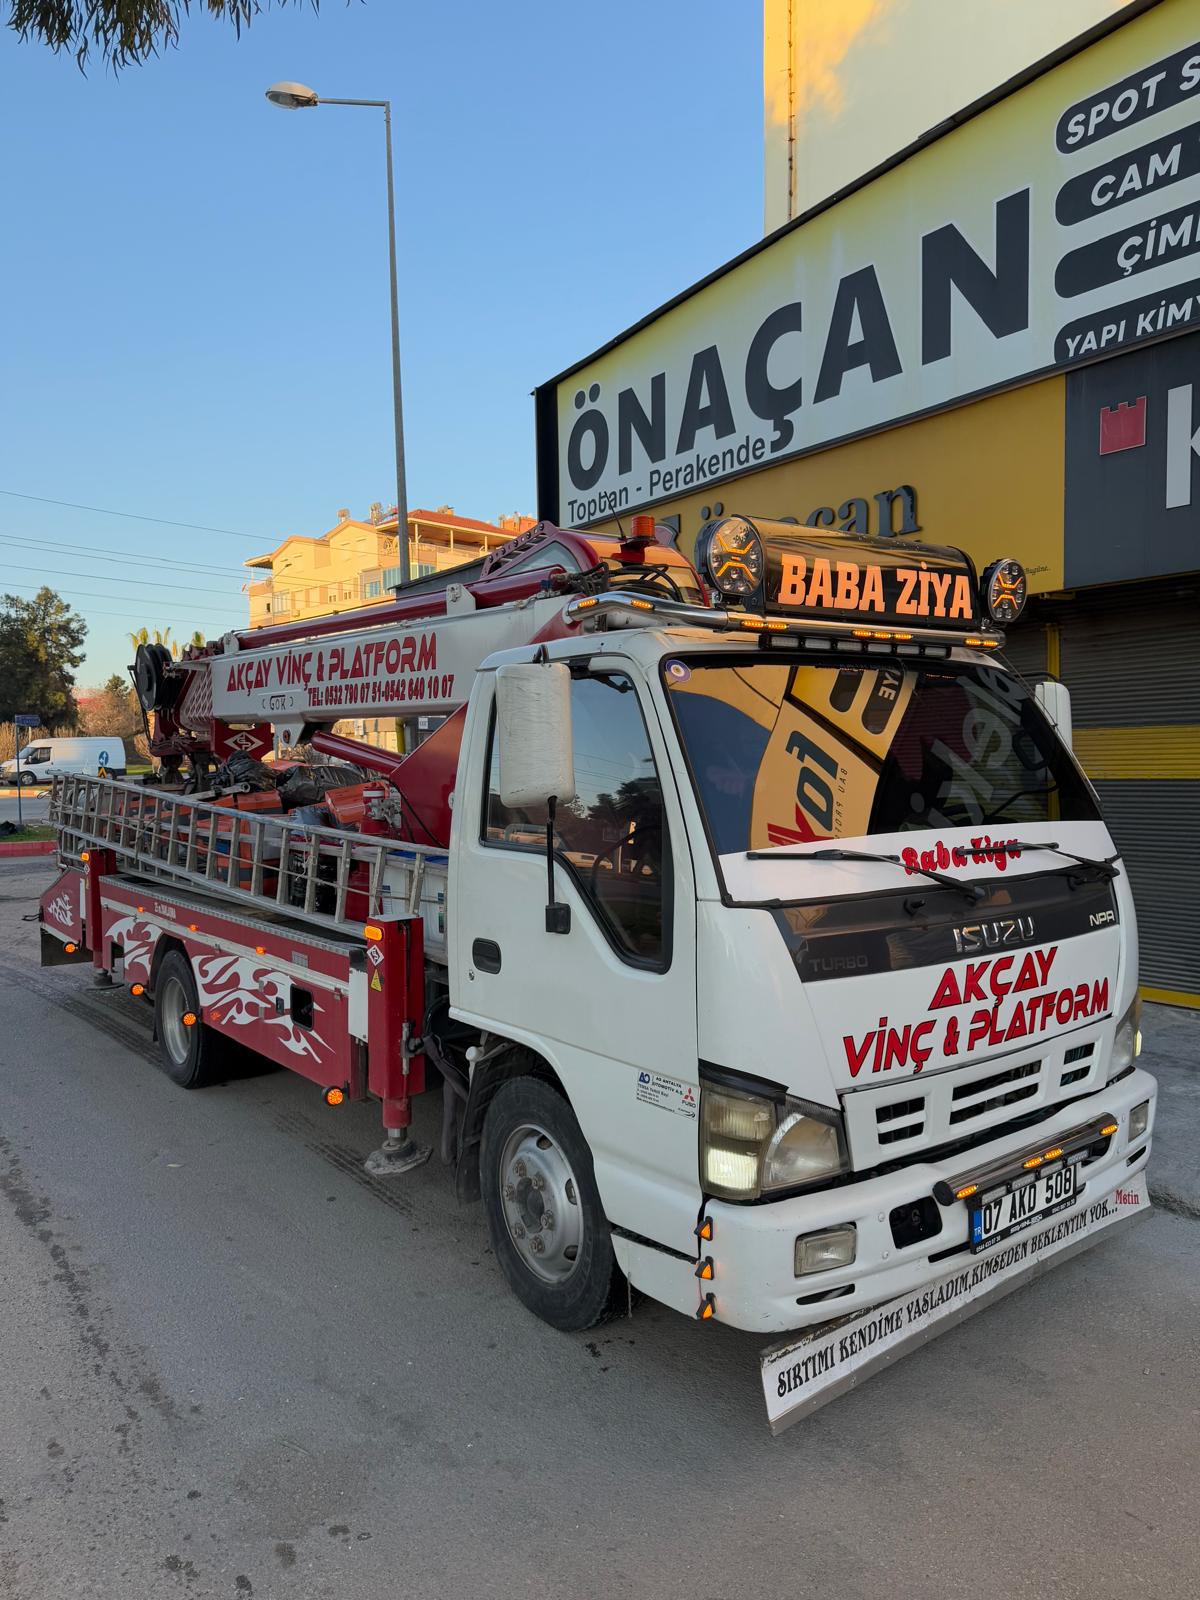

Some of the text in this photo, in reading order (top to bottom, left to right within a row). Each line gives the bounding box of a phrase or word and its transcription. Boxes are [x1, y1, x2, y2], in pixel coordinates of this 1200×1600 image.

[1065, 71, 1167, 145] SPOT
[1091, 143, 1182, 207] CAM
[1116, 212, 1200, 276] ÇİM
[568, 187, 1030, 491] ÖNAÇAN
[1065, 320, 1126, 357] YAPI
[568, 485, 629, 523] Toptan
[650, 435, 765, 496] Perakende
[777, 553, 973, 620] BABA ZİYA
[227, 632, 437, 696] AKÇAY VİNÇ & PLATFORM
[308, 687, 323, 707] TEL:
[324, 684, 342, 705] 0532
[360, 682, 370, 703] 07
[407, 677, 425, 700] 640
[427, 675, 440, 699] 10
[441, 674, 455, 698] 07
[901, 841, 967, 876] Baba
[953, 916, 1035, 952] ISUZU
[1089, 910, 1115, 927] NPR
[809, 955, 869, 973] TURBO
[928, 946, 1058, 1007] AKÇAY
[842, 977, 1109, 1078] VİNÇ & PLATFORM
[682, 1100, 696, 1108] FUSO
[983, 1202, 1003, 1235] 07
[1008, 1183, 1037, 1223] AKD
[1045, 1168, 1073, 1205] 508
[1115, 1189, 1139, 1205] Metin
[974, 1227, 982, 1236] TR
[777, 1343, 836, 1397] SIRTIMI
[839, 1312, 904, 1363] KENDİME
